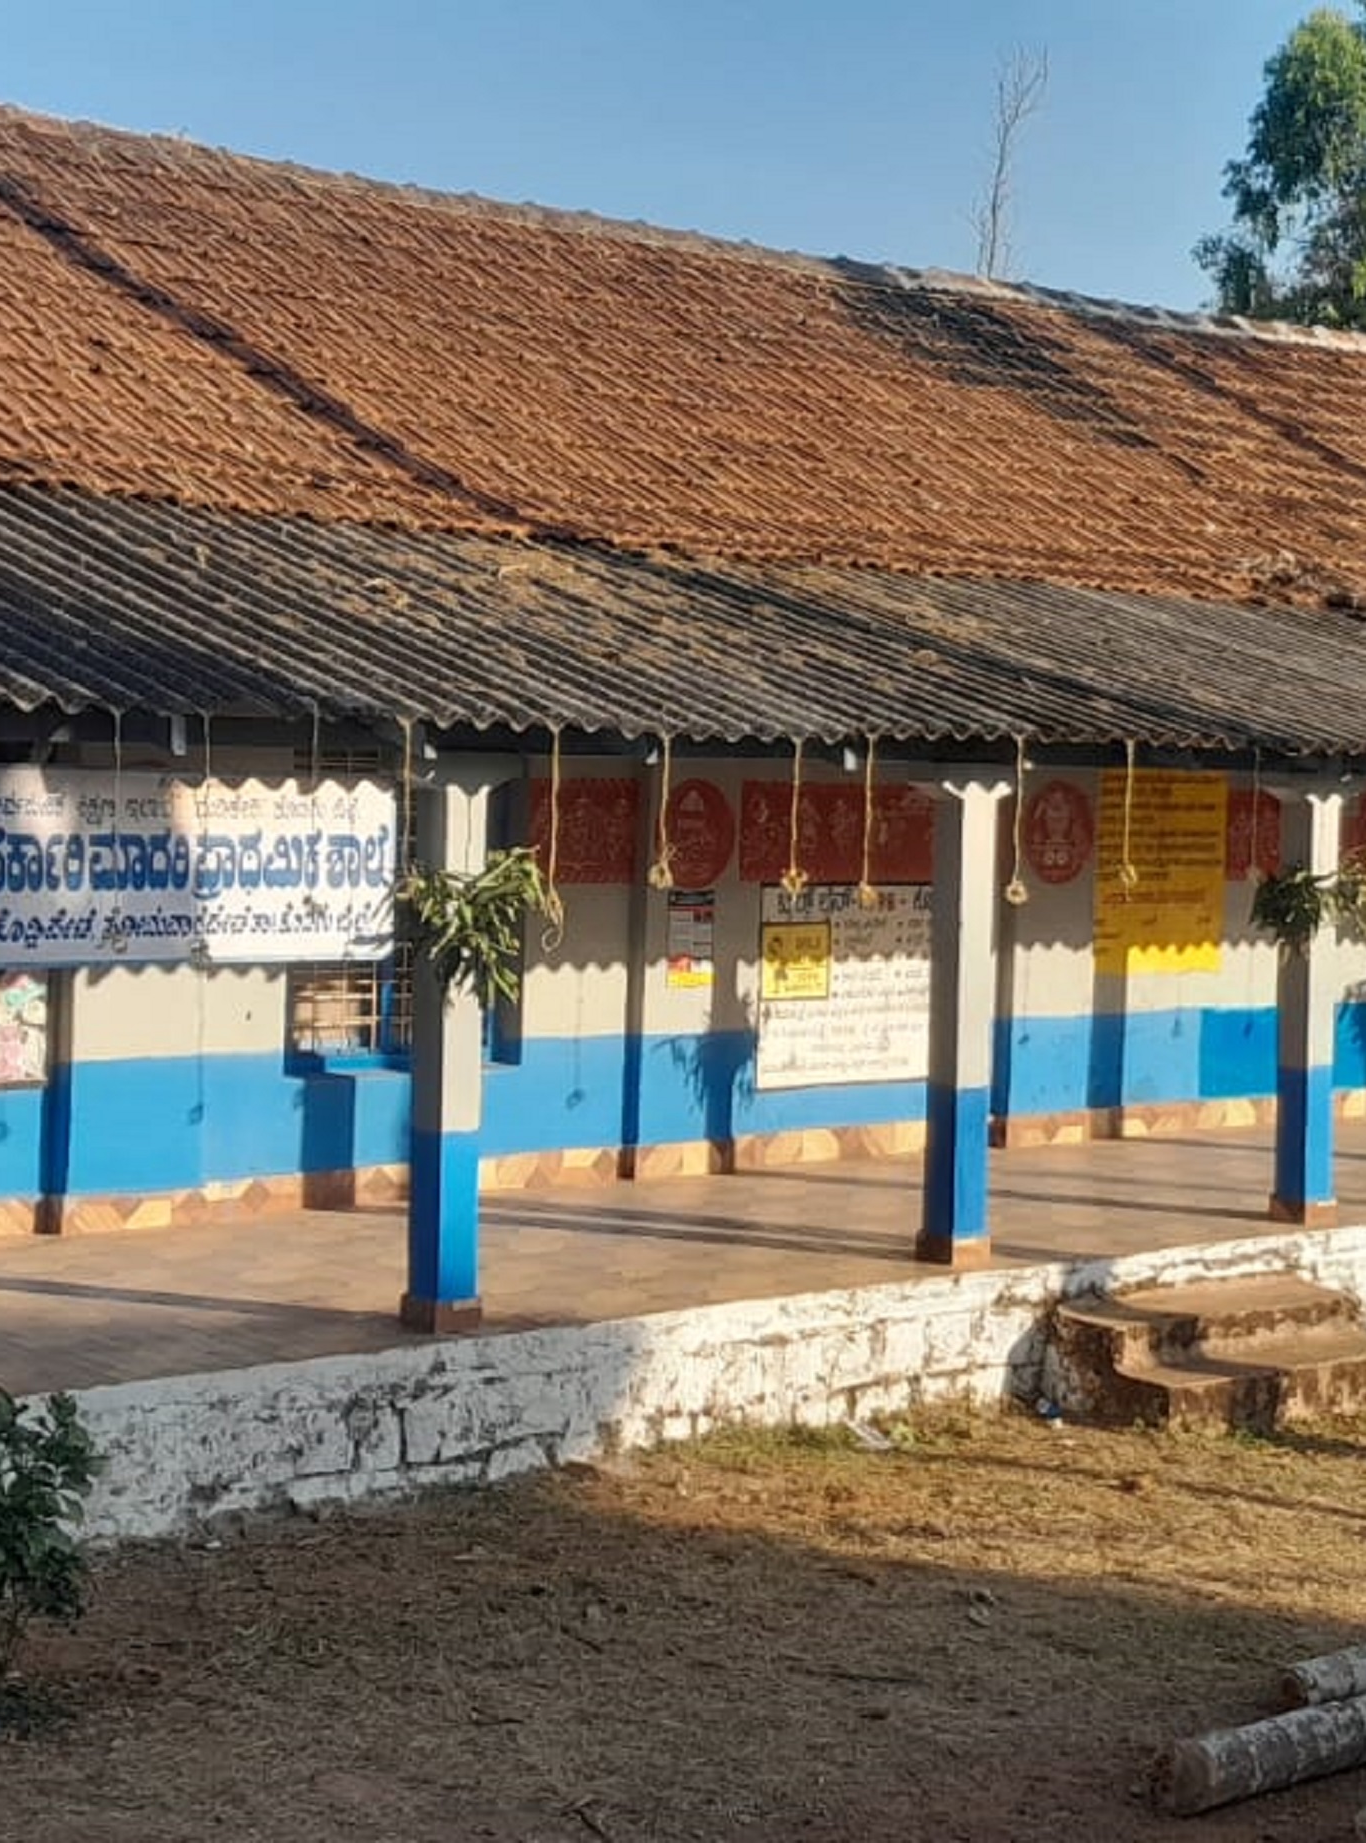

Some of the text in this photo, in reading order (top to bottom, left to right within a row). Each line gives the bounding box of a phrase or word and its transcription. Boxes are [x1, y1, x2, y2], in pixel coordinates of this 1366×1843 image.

[89, 827, 189, 891] ಮಾದರಿ
[192, 828, 322, 900] ಪ್ರಾಥಮಿಕ
[327, 823, 390, 888] ಶಾಲೆ
